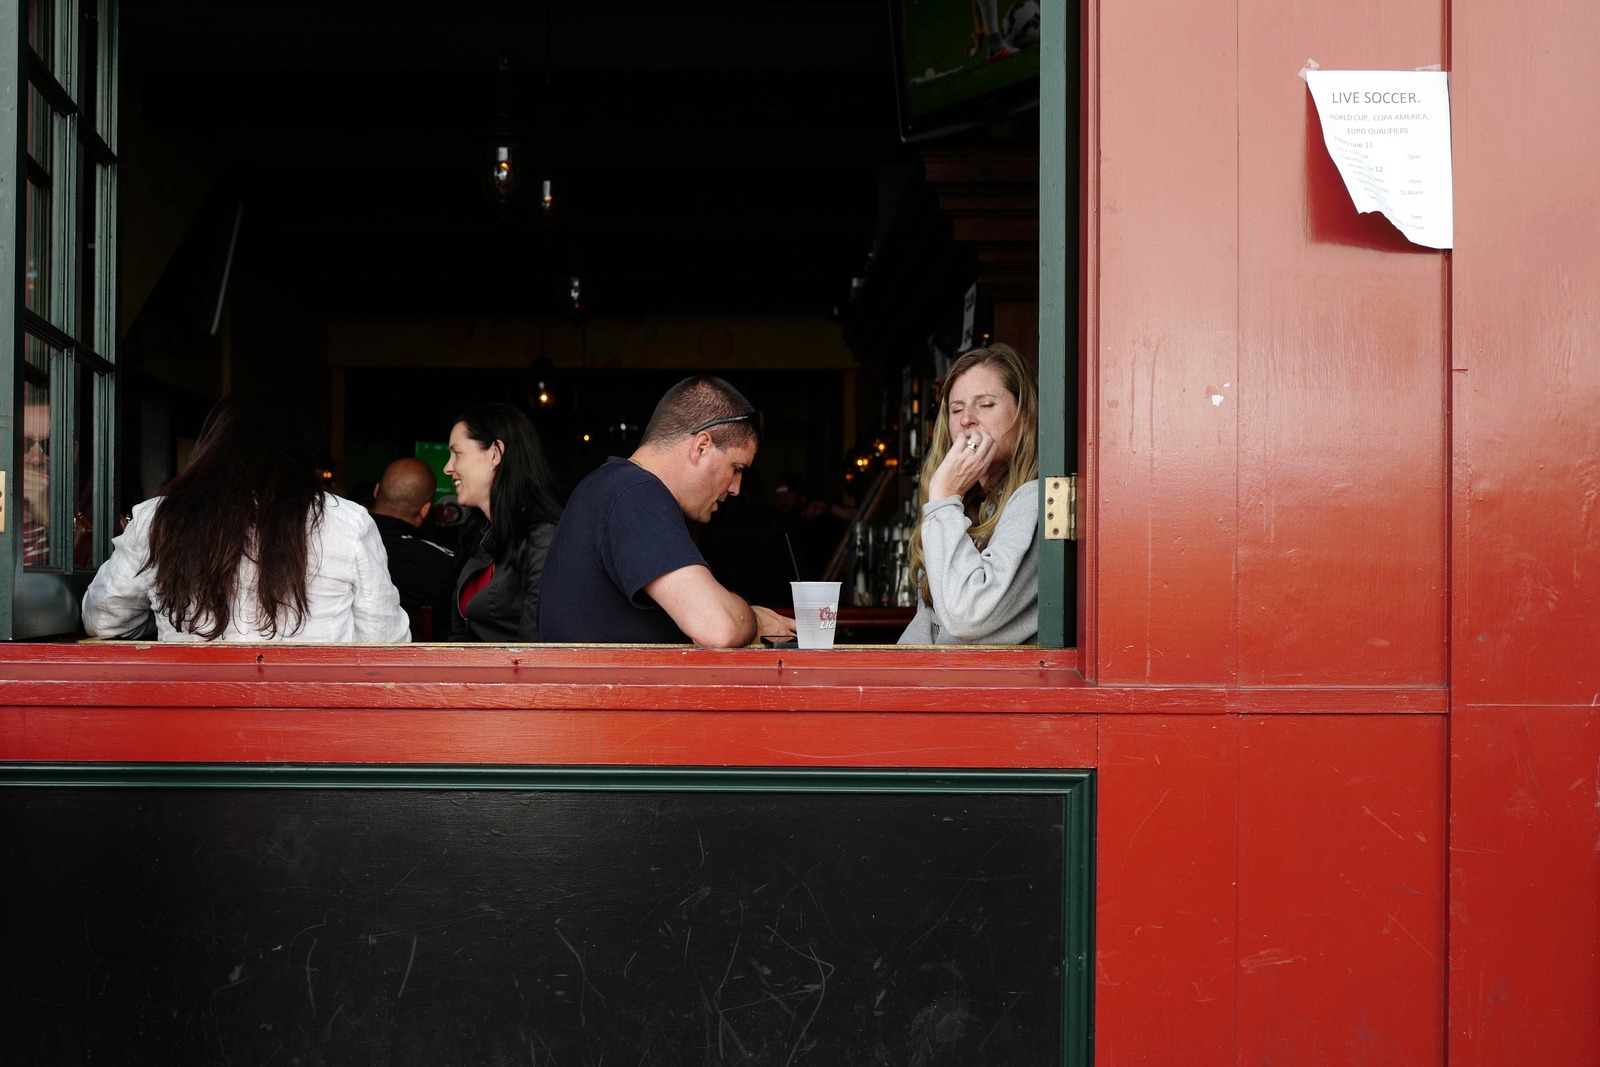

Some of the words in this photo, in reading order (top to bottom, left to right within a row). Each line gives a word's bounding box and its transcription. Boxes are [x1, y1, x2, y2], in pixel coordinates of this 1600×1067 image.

[1332, 91, 1360, 104] LIVE
[1364, 91, 1421, 104] SOCCER.
[1373, 114, 1393, 122] COPA
[1346, 127, 1367, 135] EURO
